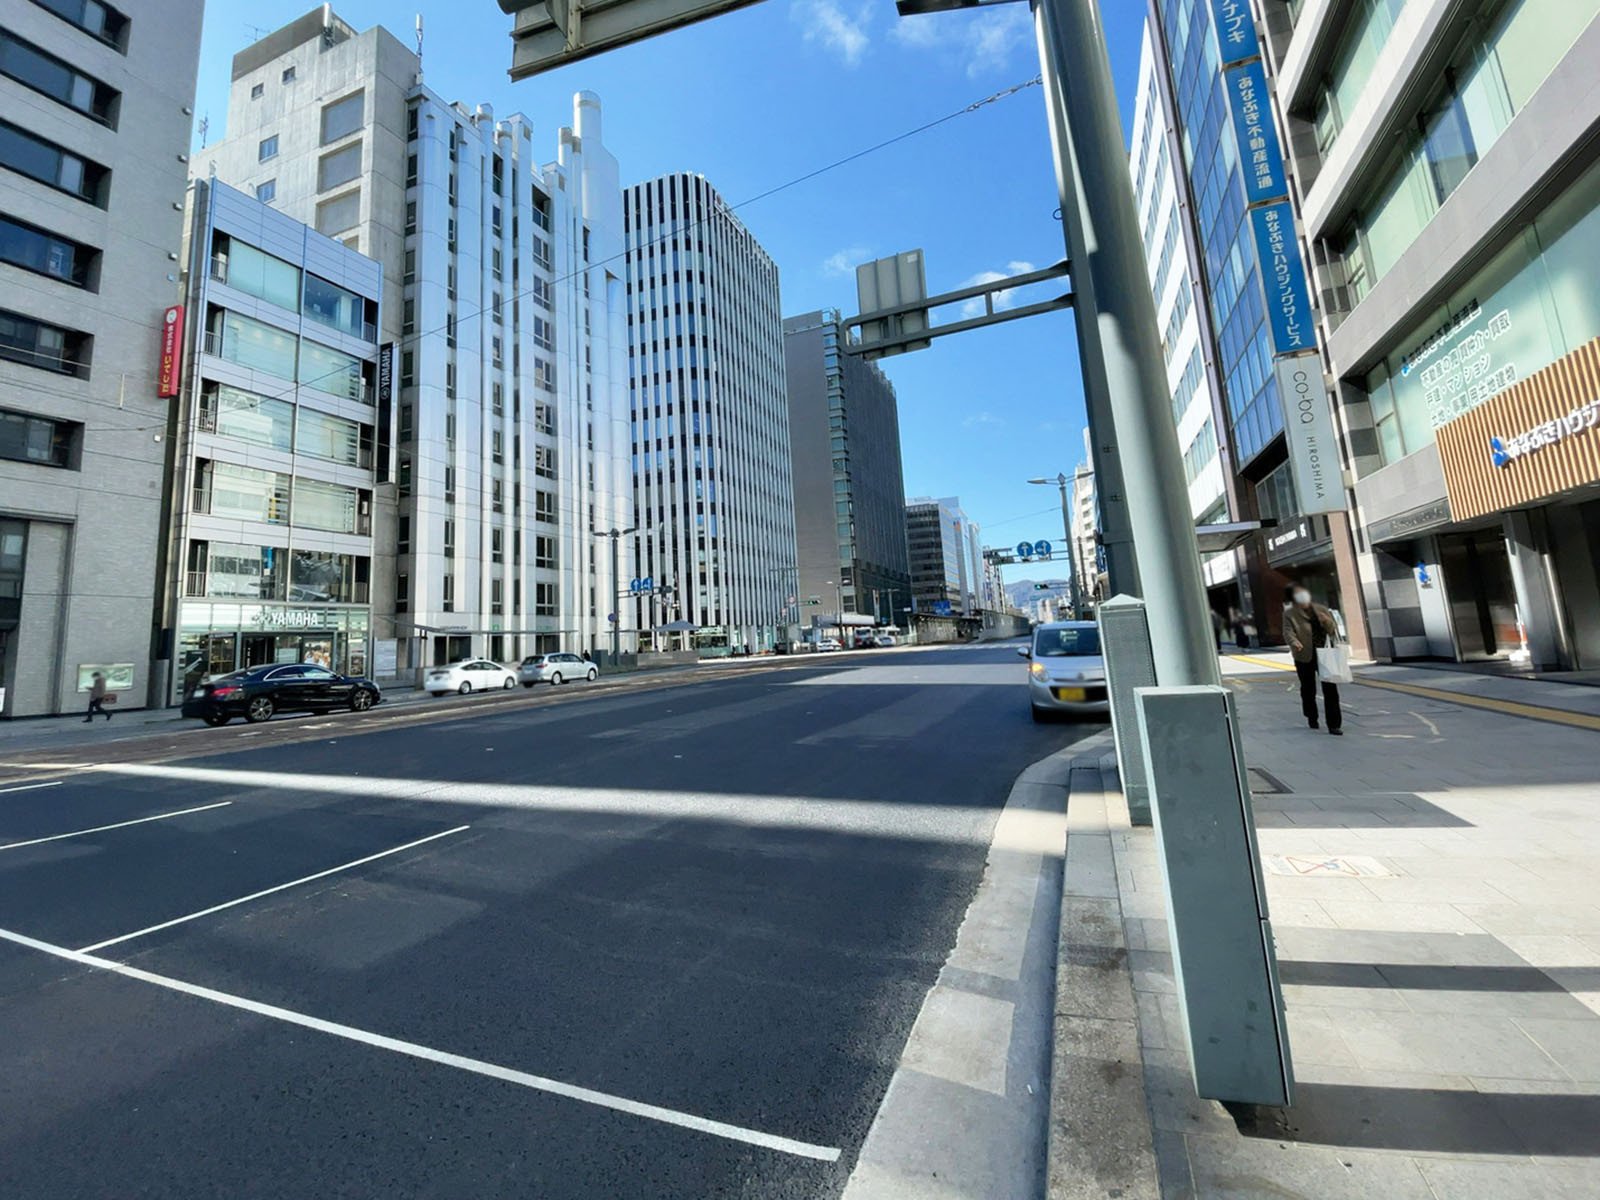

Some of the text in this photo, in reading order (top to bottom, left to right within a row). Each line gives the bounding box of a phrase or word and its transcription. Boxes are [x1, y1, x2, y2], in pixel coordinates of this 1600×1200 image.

[1222, 0, 1246, 43] ナブキ
[1239, 76, 1273, 189] あなぶき不動産流通
[1265, 210, 1302, 346] あなぶきハウジングサービス
[381, 347, 391, 387] YAMAHA
[1293, 370, 1325, 499] co-ba HIROSHIMA
[271, 611, 318, 626] YAMAHA
